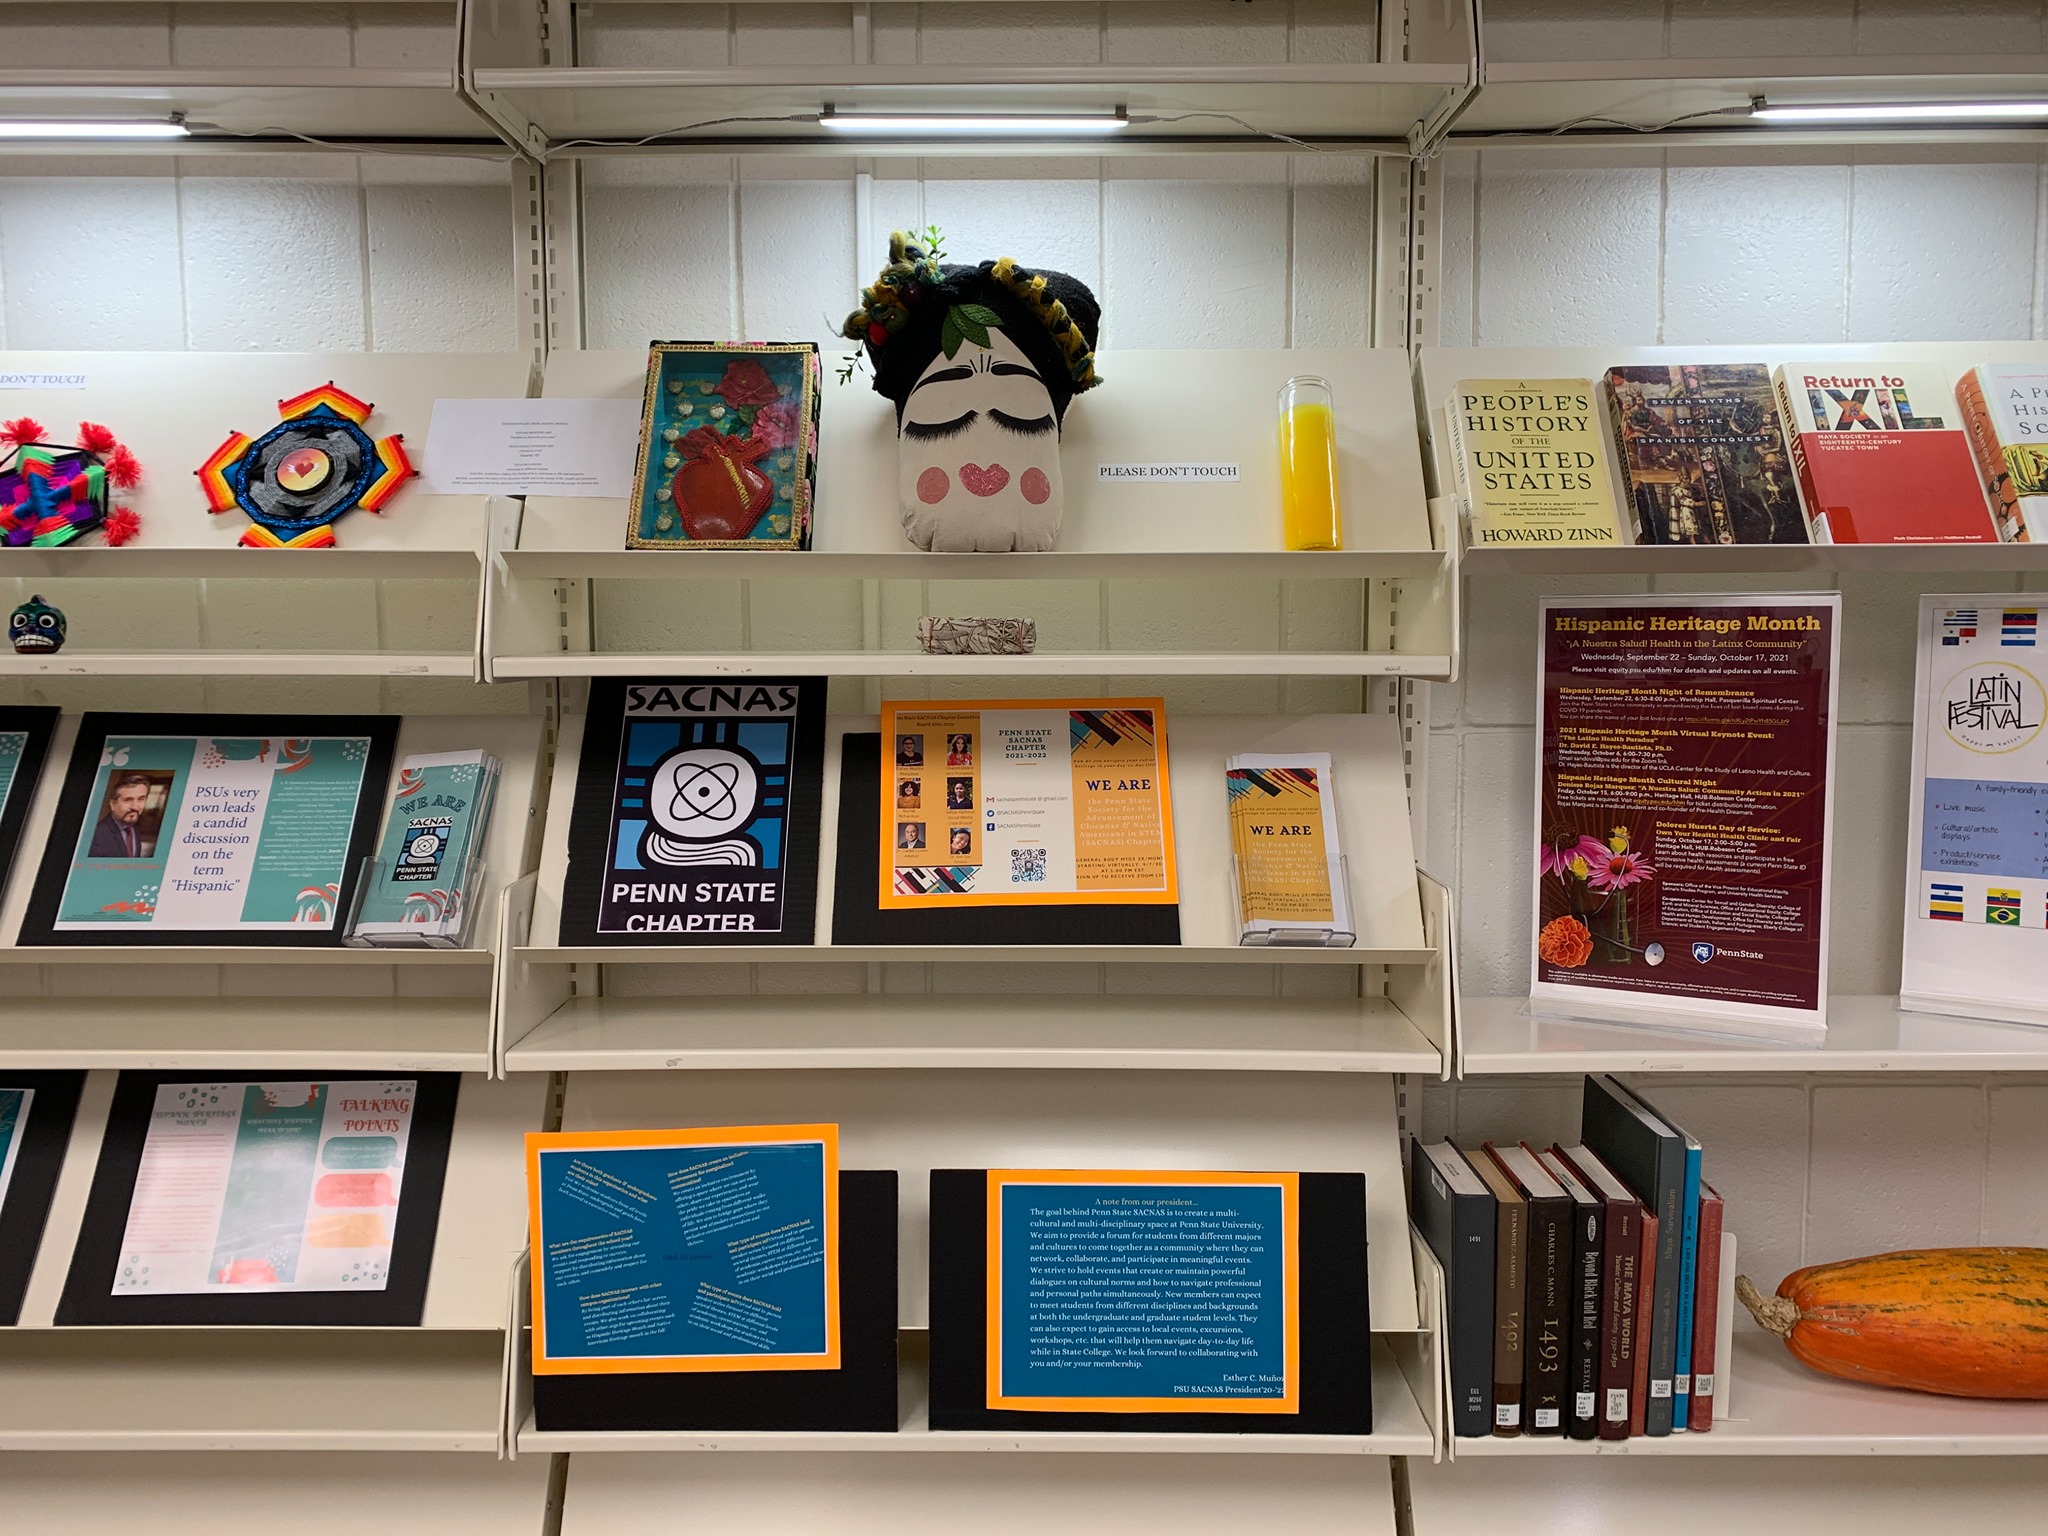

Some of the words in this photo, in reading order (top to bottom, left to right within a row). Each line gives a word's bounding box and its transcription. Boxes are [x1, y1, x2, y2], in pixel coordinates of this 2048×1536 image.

[0, 375, 40, 384] DON'T
[42, 375, 86, 384] TOUCH
[1803, 375, 1876, 389] Return
[1881, 375, 1905, 388] to
[2010, 388, 2024, 399] A
[1462, 395, 1589, 411] PEOPLE'S
[1777, 381, 1792, 424] Return
[1807, 389, 1945, 430] IXIL
[1466, 416, 1589, 432] HISTORY
[1789, 423, 1796, 439] to
[1511, 437, 1525, 445] OF
[1529, 437, 1551, 445] THE
[1702, 435, 1770, 443] CONQUEST
[1473, 451, 1595, 469] UNITED
[1792, 438, 1806, 477] IXIL
[1100, 467, 1147, 476] PLEASE
[1150, 466, 1189, 476] DON'T
[1191, 467, 1237, 476] TOUCH
[1484, 473, 1592, 490] STATES
[1480, 529, 1563, 542] HOWARD
[1567, 528, 1612, 542] ZINN
[1555, 617, 1644, 634] Hispanic
[1649, 616, 1742, 634] Heritage
[1746, 615, 1821, 631] Month
[1582, 640, 1617, 648] Nuestra
[1620, 639, 1647, 648] Salud!
[1650, 640, 1680, 648] Health
[1712, 640, 1743, 648] Latinx
[1745, 640, 1807, 649] Community"
[1581, 653, 1625, 661] Wednesday,
[1627, 654, 1668, 662] September
[1688, 654, 1718, 662] Sunday,
[1755, 654, 1767, 662] 17,
[627, 686, 797, 713] SACNAS
[1948, 700, 2039, 730] FESTIVAL
[1085, 780, 1112, 791] WE
[1117, 779, 1151, 791] ARE
[1975, 784, 1982, 792] A
[1986, 785, 2037, 797] family-friendly
[195, 786, 229, 798] PSUs
[233, 789, 260, 800] very
[192, 804, 219, 813] own
[223, 802, 255, 813] leads
[399, 796, 429, 815] WE
[431, 794, 467, 813] ARE
[1088, 806, 1120, 814] Society
[1943, 804, 1961, 812] Live
[1964, 805, 1987, 813] music
[192, 820, 200, 828] a
[203, 817, 248, 829] candid
[408, 817, 454, 827] SACNAS
[1941, 824, 1999, 834] Cultural/artistic
[1249, 825, 1274, 836] WE
[1280, 825, 1312, 836] ARE
[1941, 832, 1971, 842] displays
[183, 832, 249, 844] discussion
[192, 851, 208, 859] on
[213, 848, 233, 859] the
[1940, 850, 2001, 860] Product/service
[193, 865, 224, 875] term
[172, 879, 240, 894] "Hispanic"
[611, 883, 687, 903] PENN
[695, 883, 776, 902] STATE
[626, 914, 756, 931] CHAPTER
[1716, 948, 1764, 960] PennState
[340, 1098, 409, 1114] TALKING
[343, 1118, 400, 1133] POINTS
[1121, 1198, 1140, 1206] from
[1030, 1208, 1045, 1216] The
[1045, 1208, 1062, 1217] goal
[1063, 1208, 1090, 1216] behind
[1091, 1208, 1111, 1216] Penn
[1112, 1208, 1132, 1216] State
[1133, 1208, 1166, 1216] SACNAS
[1184, 1209, 1208, 1217] create
[1215, 1209, 1240, 1217] multi-
[1077, 1220, 1146, 1229] multi-disciplinary
[1147, 1221, 1168, 1229] space
[1200, 1221, 1220, 1229] State
[1221, 1221, 1265, 1230] University.
[1469, 1235, 1481, 1243] 1491
[1548, 1222, 1556, 1265] CHARLES
[1582, 1251, 1600, 1280] Beyond
[1624, 1255, 1634, 1278] THE
[1547, 1277, 1555, 1307] MANN
[1583, 1280, 1599, 1300] Black
[1622, 1281, 1633, 1315] MAYA
[1583, 1301, 1598, 1314] and
[1583, 1315, 1597, 1330] Red
[1501, 1311, 1519, 1352] 1492
[1620, 1317, 1632, 1360] WORLD
[1538, 1318, 1559, 1373] 1493
[1223, 1374, 1248, 1382] Esther
[1249, 1374, 1257, 1382] C.
[1174, 1385, 1190, 1393] PSU
[1191, 1385, 1224, 1393] SACNAS
